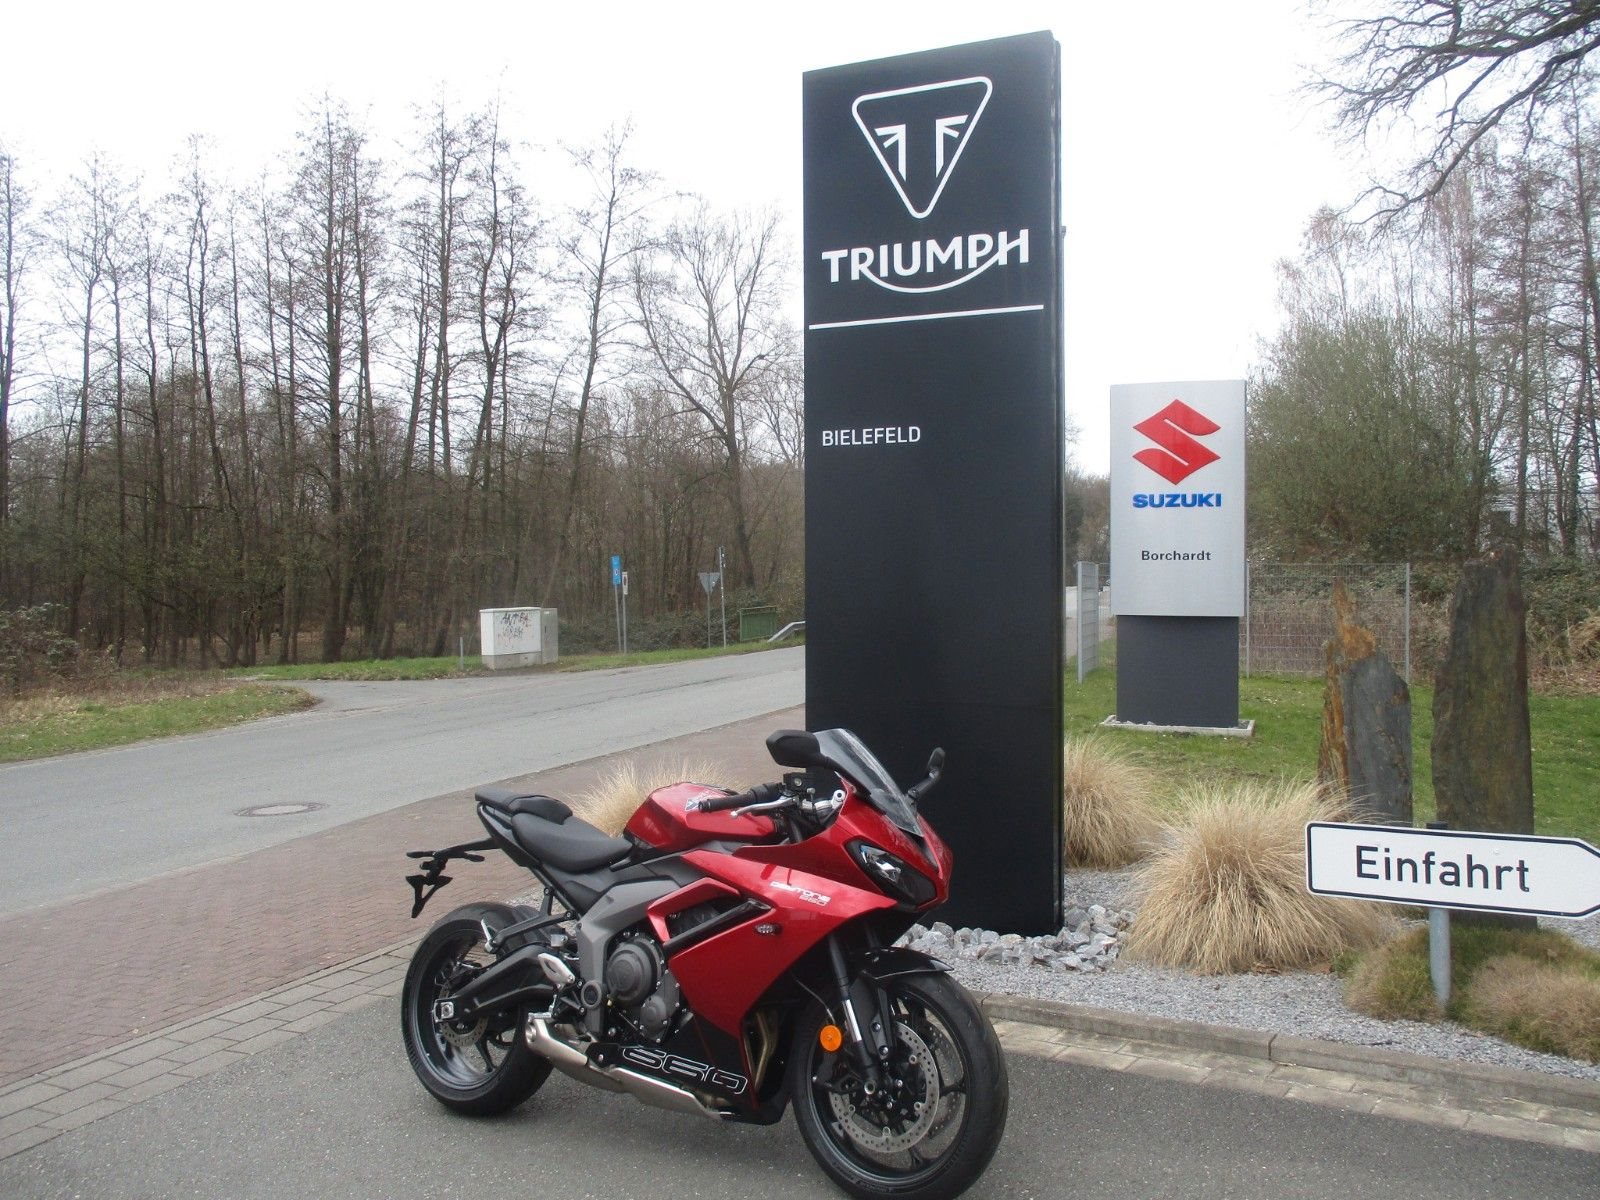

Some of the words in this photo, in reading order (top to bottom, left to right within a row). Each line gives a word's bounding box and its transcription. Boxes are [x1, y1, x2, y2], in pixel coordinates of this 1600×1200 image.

[821, 229, 1029, 293] TRIUMPH
[822, 426, 921, 446] BIELEFELD
[1132, 493, 1222, 508] SUZUKI
[1141, 550, 1212, 561] Borchardt
[1356, 845, 1530, 892] Einfahrt
[622, 1047, 748, 1095] 660
